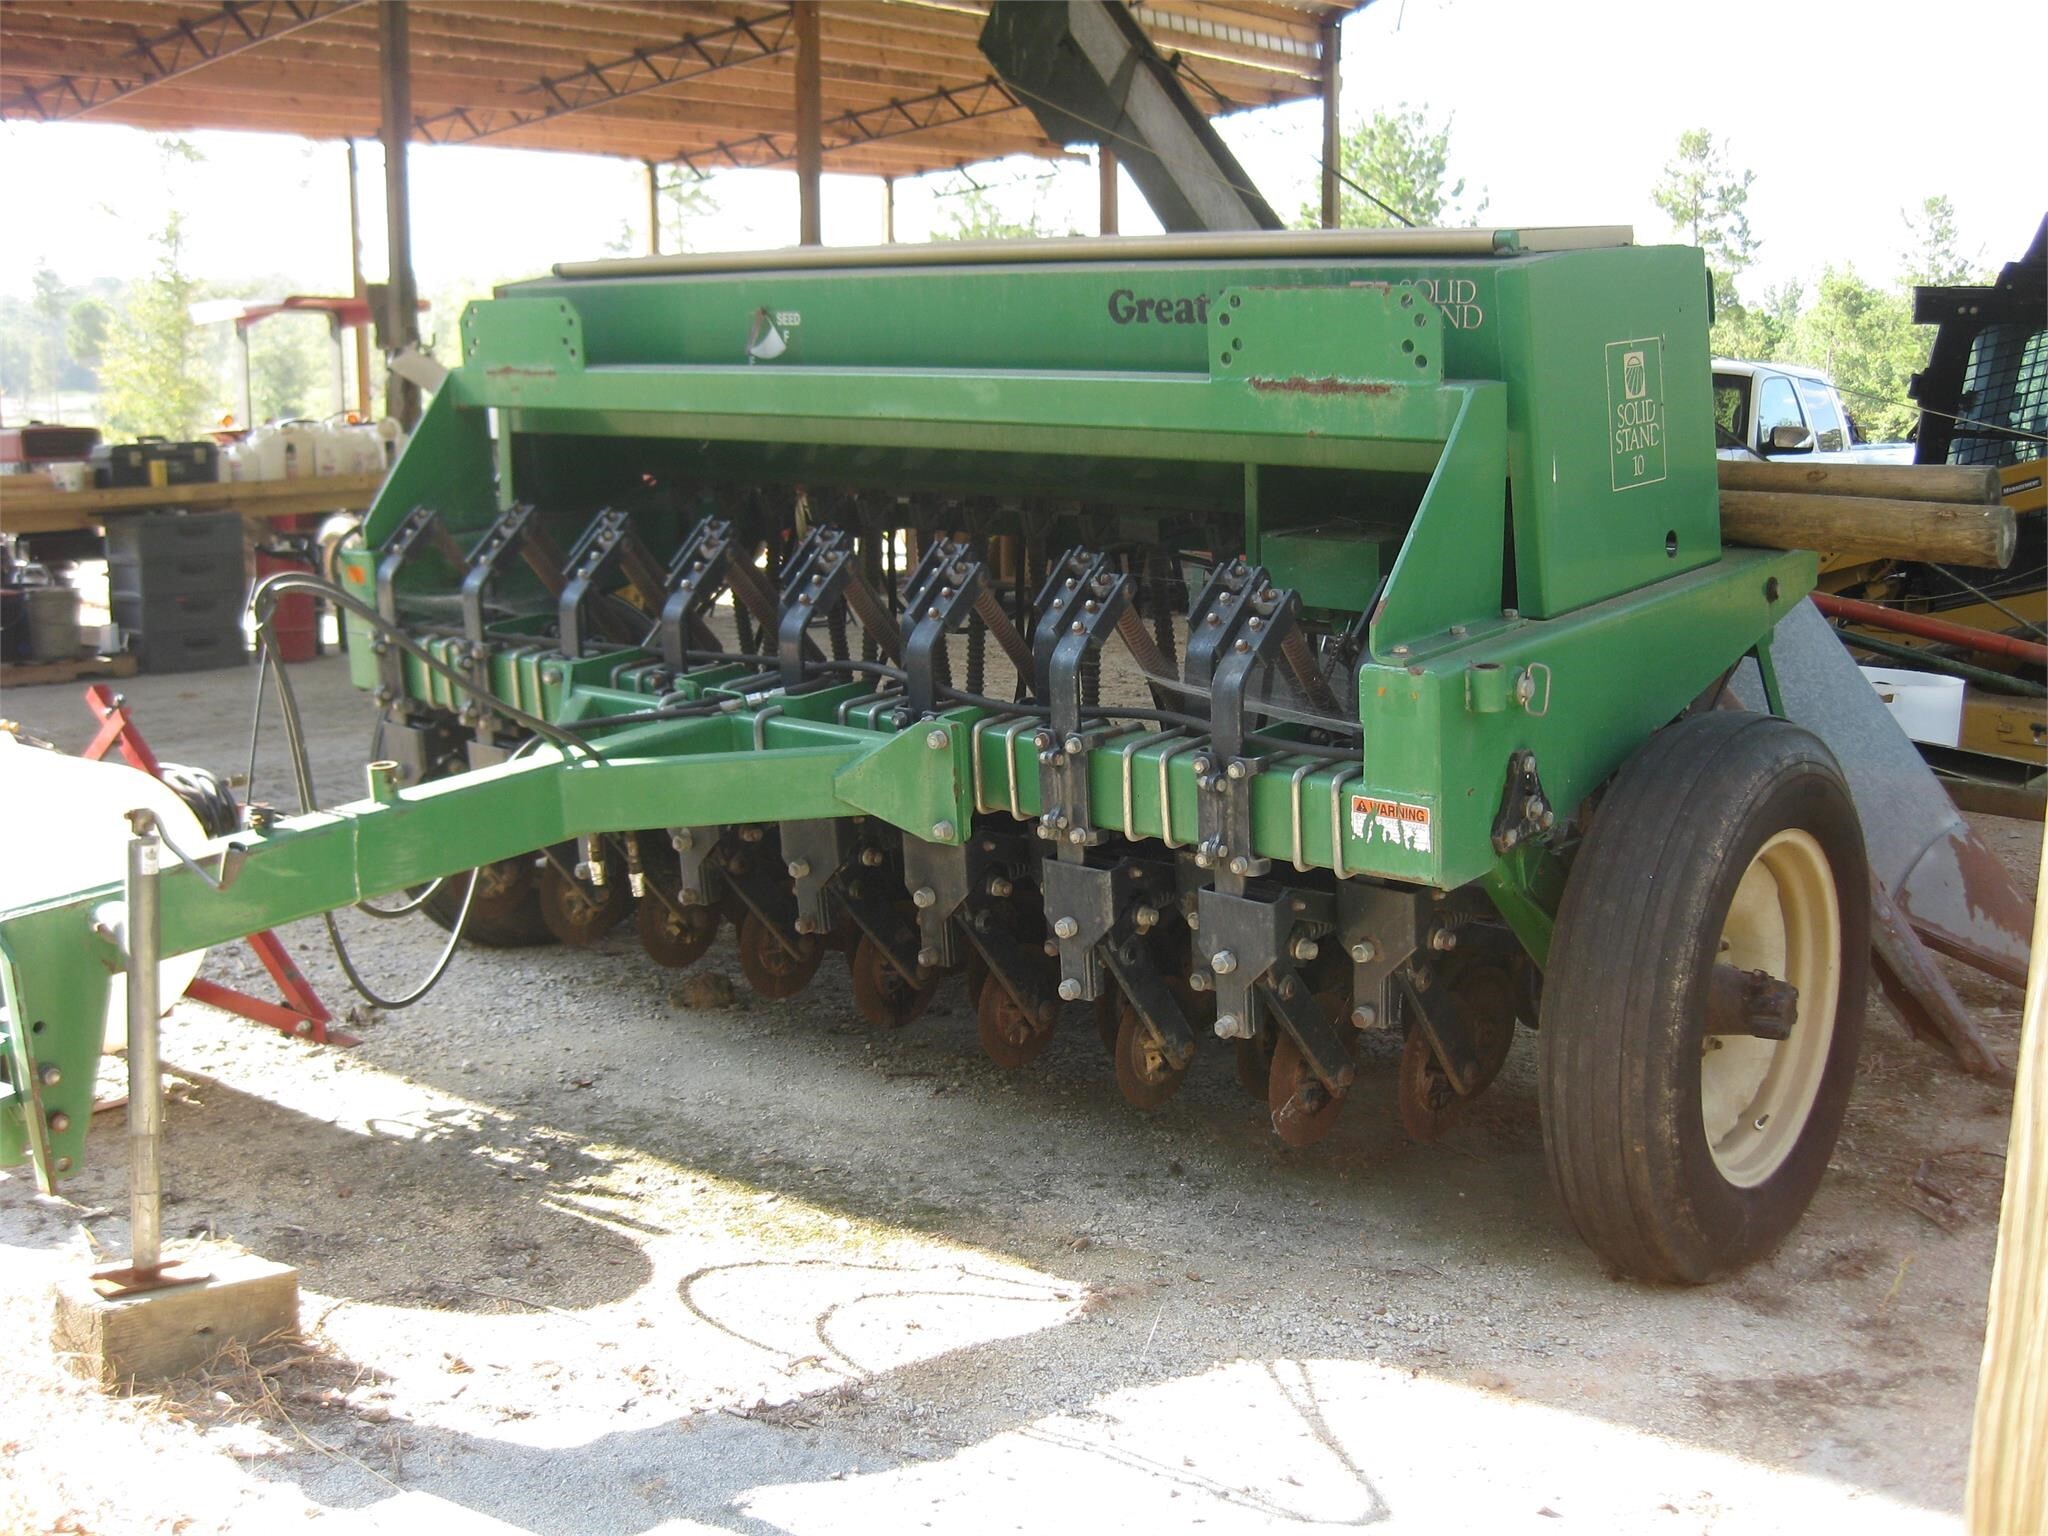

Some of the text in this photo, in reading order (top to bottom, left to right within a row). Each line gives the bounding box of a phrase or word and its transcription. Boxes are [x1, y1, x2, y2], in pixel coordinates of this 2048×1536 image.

[775, 312, 801, 326] SEED
[1108, 289, 1211, 325] Great
[1617, 400, 1656, 428] SOLID
[1632, 454, 1645, 477] 10
